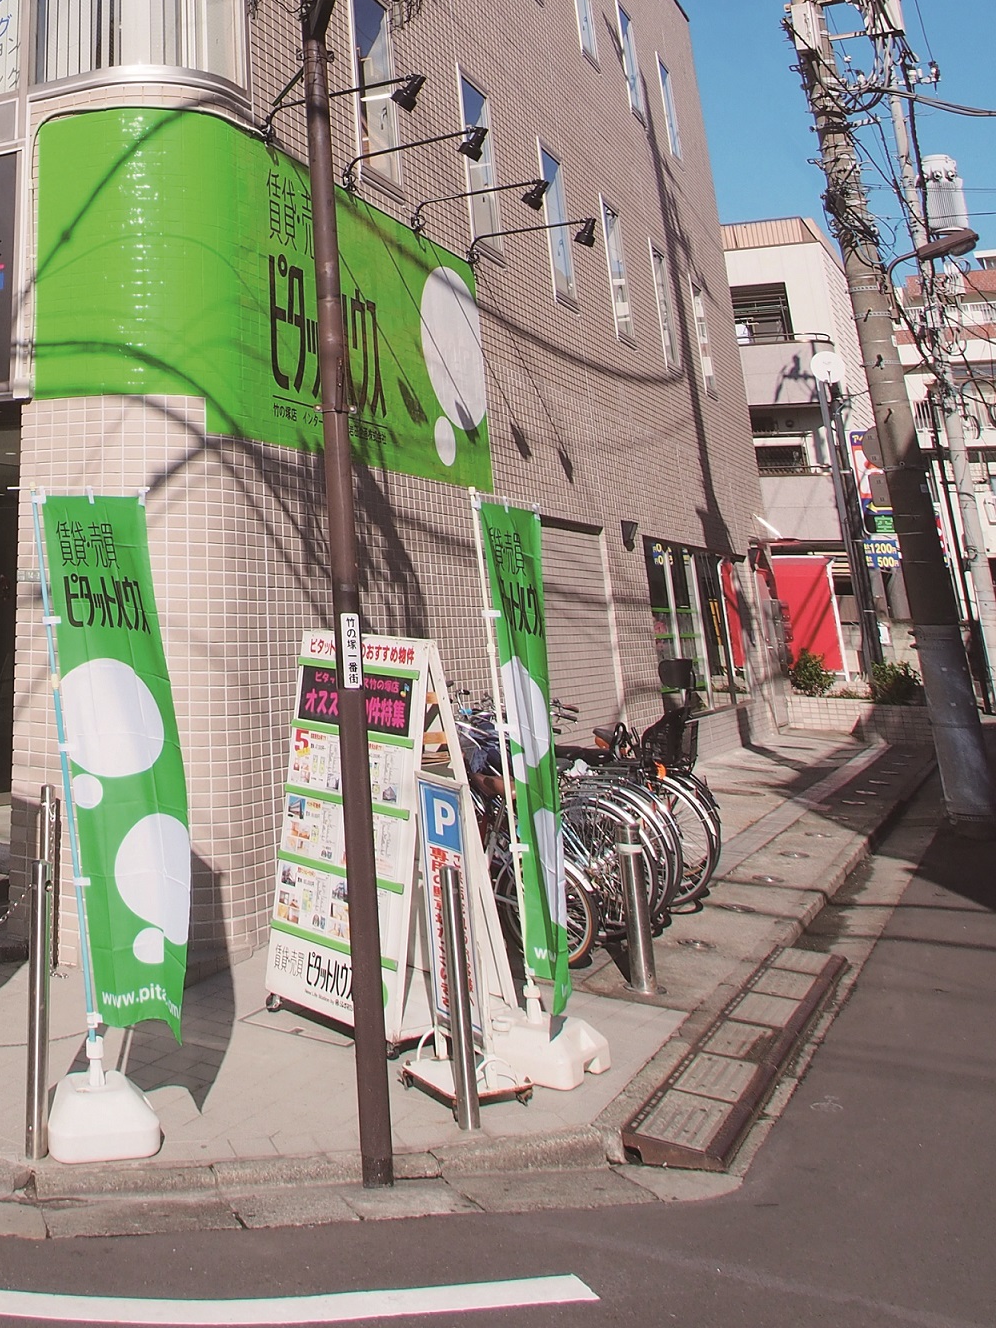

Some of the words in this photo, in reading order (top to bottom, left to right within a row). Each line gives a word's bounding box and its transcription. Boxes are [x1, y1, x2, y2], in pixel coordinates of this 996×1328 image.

[272, 402, 298, 422] 竹の塚店
[55, 520, 120, 571] 賃貸・売買
[62, 573, 152, 635] ピタットハウス
[345, 616, 360, 684] 竹の塚一番街
[433, 798, 456, 836] P
